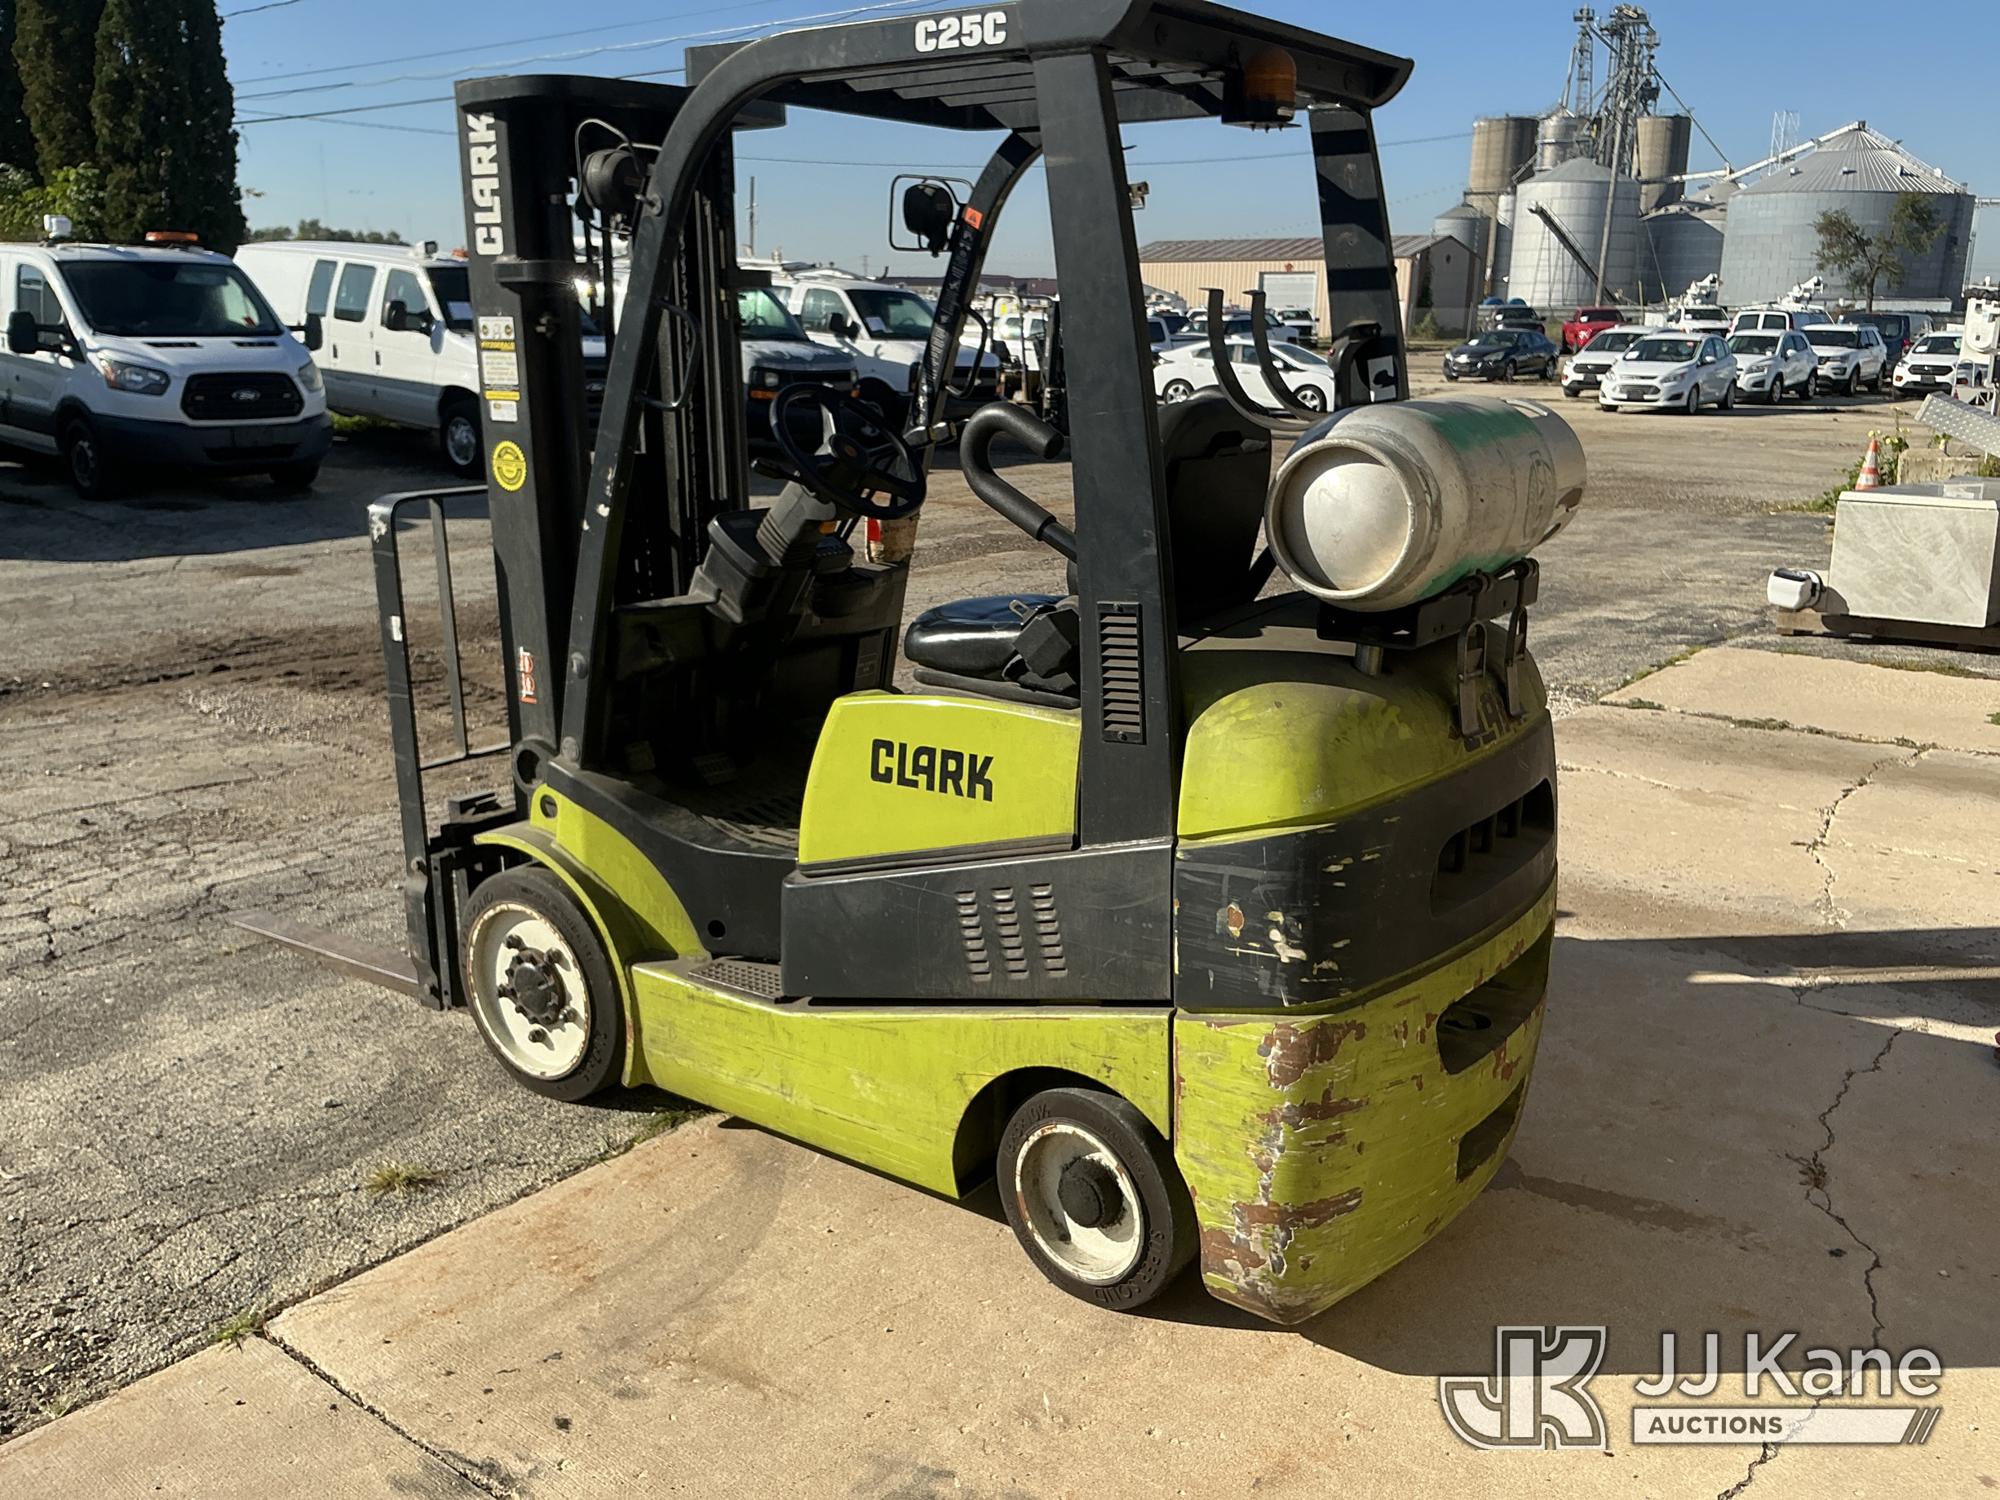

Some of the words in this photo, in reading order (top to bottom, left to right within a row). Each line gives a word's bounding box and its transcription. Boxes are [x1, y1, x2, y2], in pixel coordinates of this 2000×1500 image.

[914, 11, 1007, 52] C25C
[466, 112, 504, 256] CLARK
[870, 738, 994, 802] CLARK
